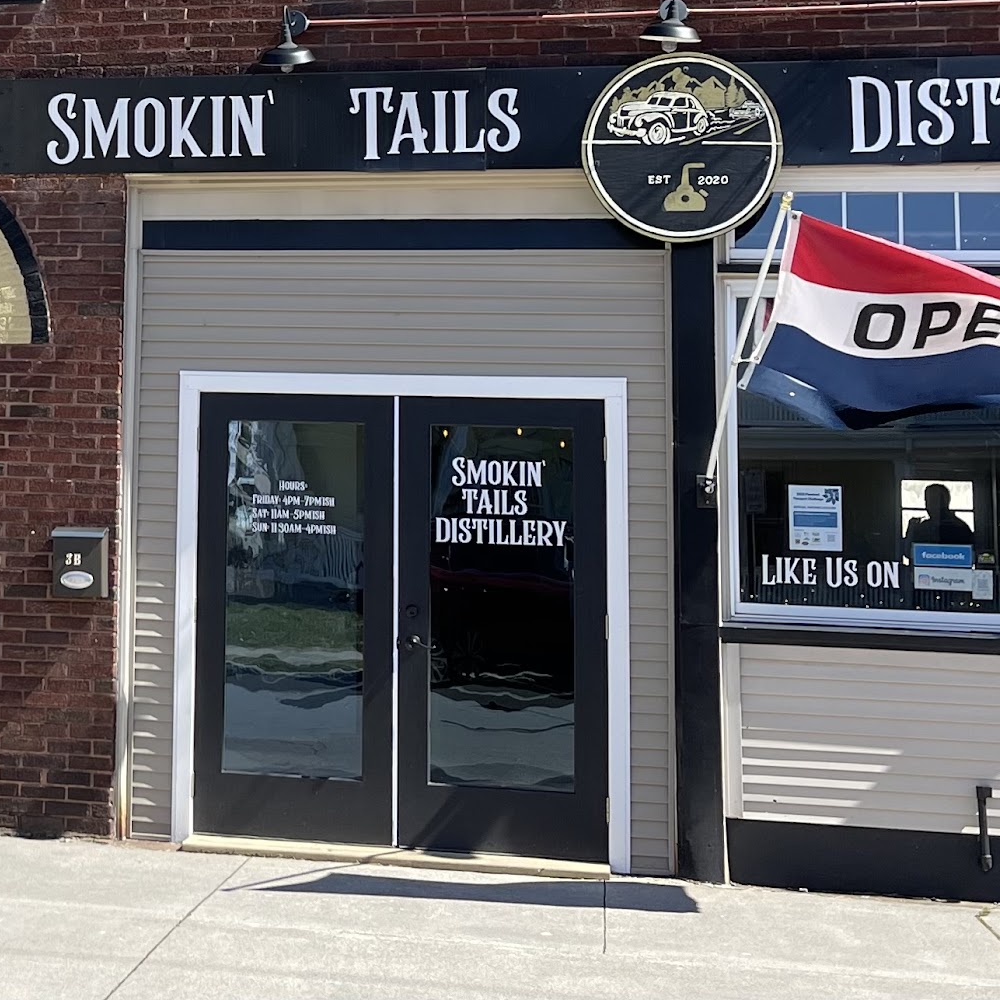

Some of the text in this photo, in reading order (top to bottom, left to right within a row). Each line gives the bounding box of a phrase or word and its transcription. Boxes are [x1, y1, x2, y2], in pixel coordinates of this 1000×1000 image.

[46, 75, 1000, 165] SMOKIN' TAILS DIST
[647, 174, 729, 186] EST 2020
[451, 456, 546, 487] SMOKIN'
[461, 488, 528, 516] TAILS
[435, 516, 567, 547] DISTILLERY
[65, 552, 82, 566] 3B
[921, 551, 966, 560] facebook
[761, 554, 900, 589] LIKE US ON
